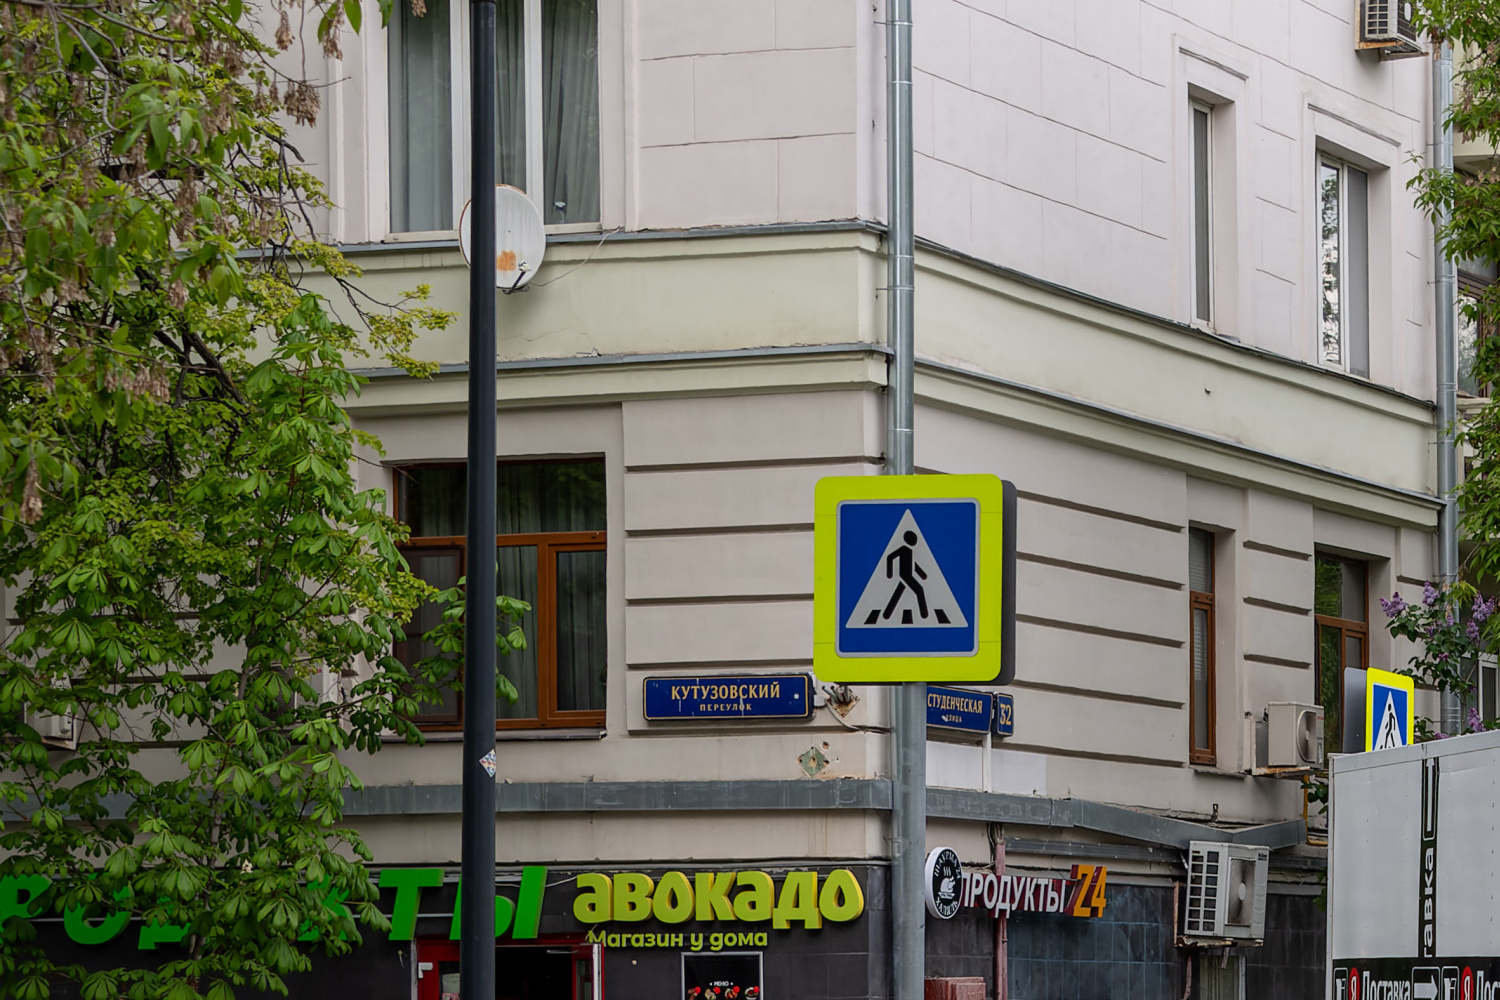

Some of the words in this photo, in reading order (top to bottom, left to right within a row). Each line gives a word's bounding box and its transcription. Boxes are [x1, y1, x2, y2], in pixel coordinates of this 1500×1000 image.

[671, 681, 780, 700] КУТУЗОВСКИЙ
[700, 703, 752, 711] ПЕРЕУЛОК
[927, 694, 982, 713] СТУДЕНЧЕСКАЯ
[1000, 703, 1011, 725] 32
[934, 851, 957, 877] ШАУРМА
[962, 873, 1066, 918] ПРОДУКТЫ
[1073, 864, 1107, 918] 24
[588, 930, 683, 947] Магазин
[690, 933, 703, 951] у
[709, 932, 768, 951] дома
